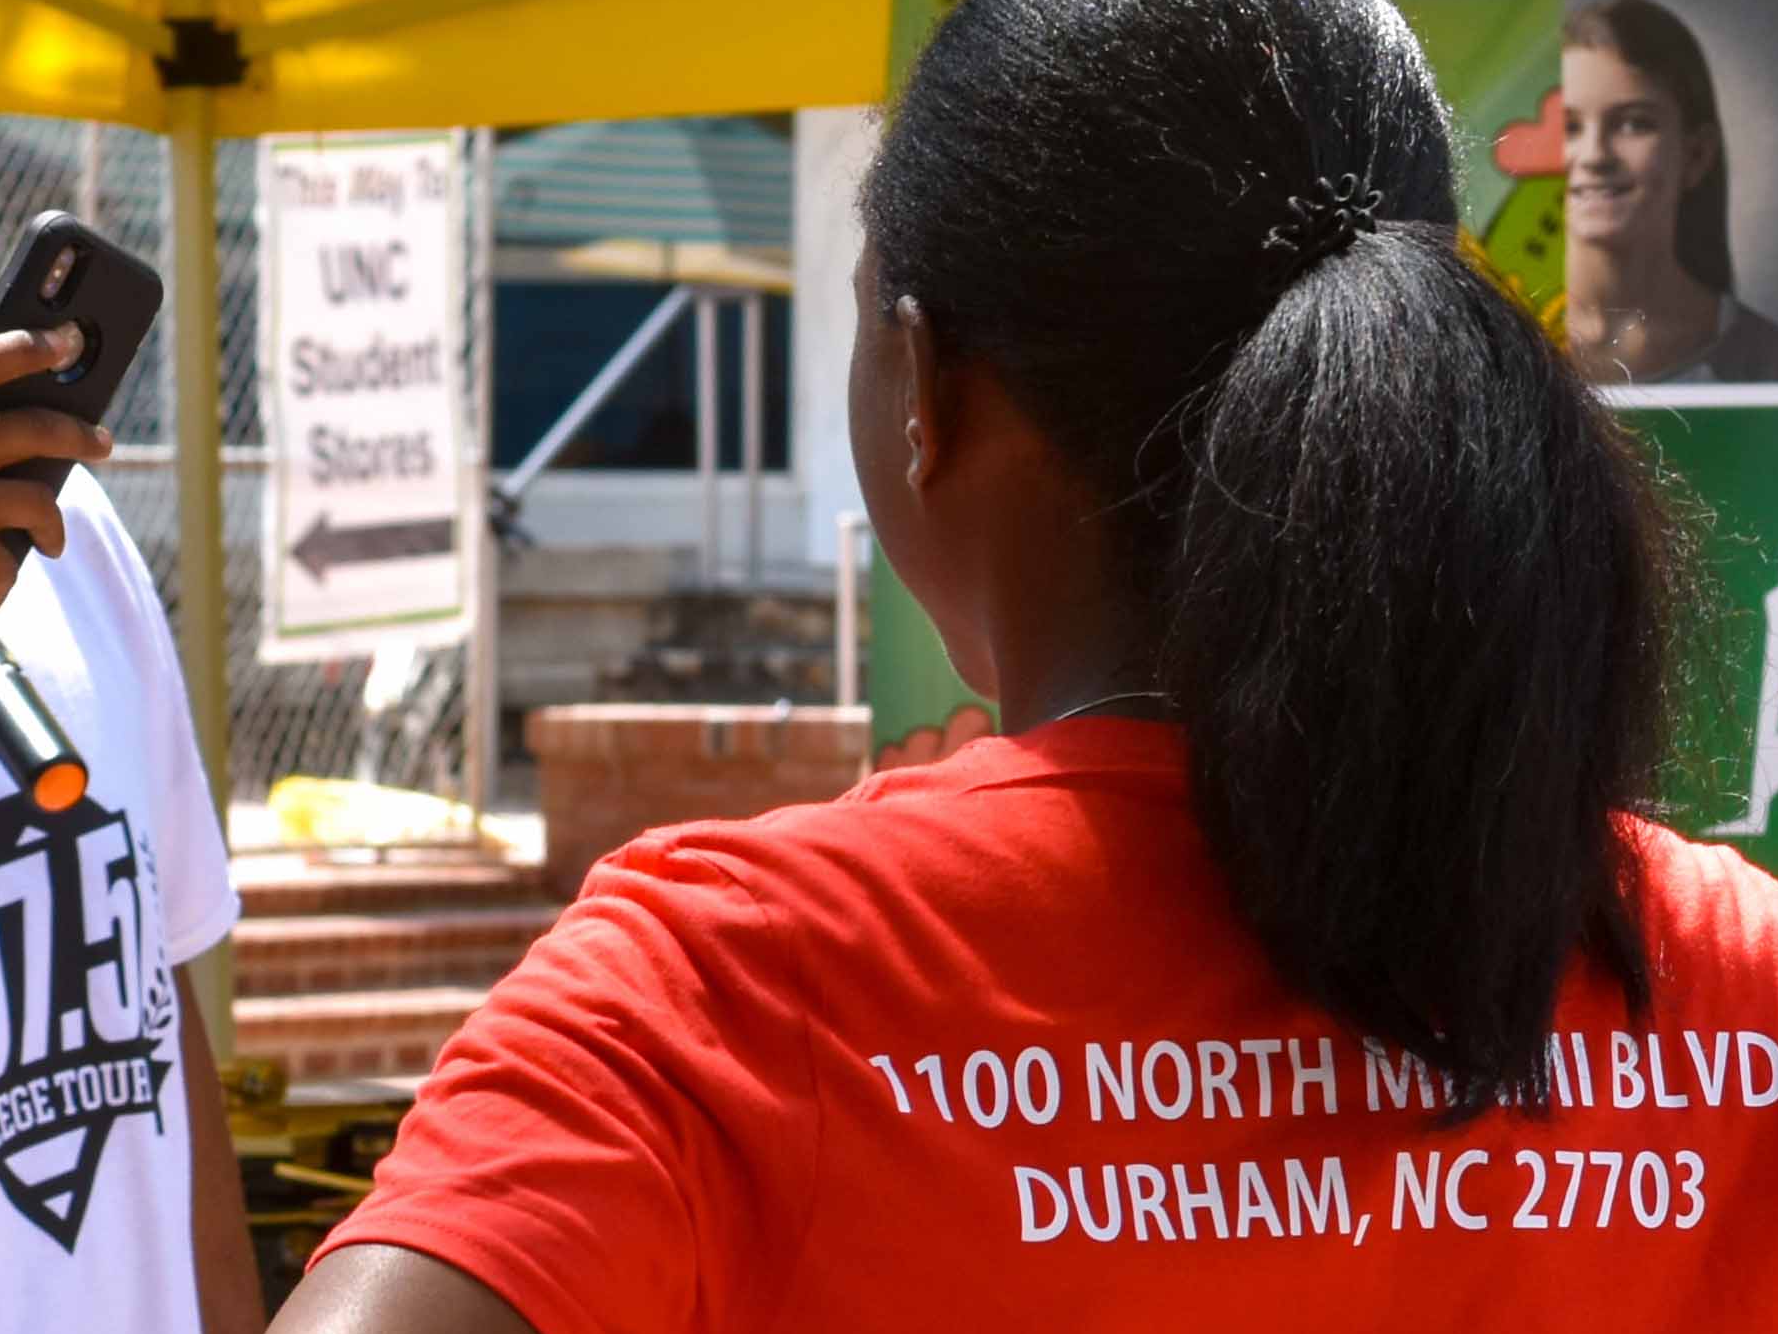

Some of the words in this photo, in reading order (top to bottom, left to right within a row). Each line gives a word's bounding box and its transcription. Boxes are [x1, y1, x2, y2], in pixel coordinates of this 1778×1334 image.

[320, 241, 409, 305] UNC
[289, 334, 442, 398] Student
[308, 423, 435, 485] Stores
[52, 1057, 153, 1116] TOUR
[869, 1045, 1061, 1128] 1100
[1084, 1038, 1338, 1122] NORTH
[1012, 1156, 1372, 1247] DURHAM,
[1390, 1148, 1490, 1231] NC
[1511, 1148, 1706, 1230] 27703
